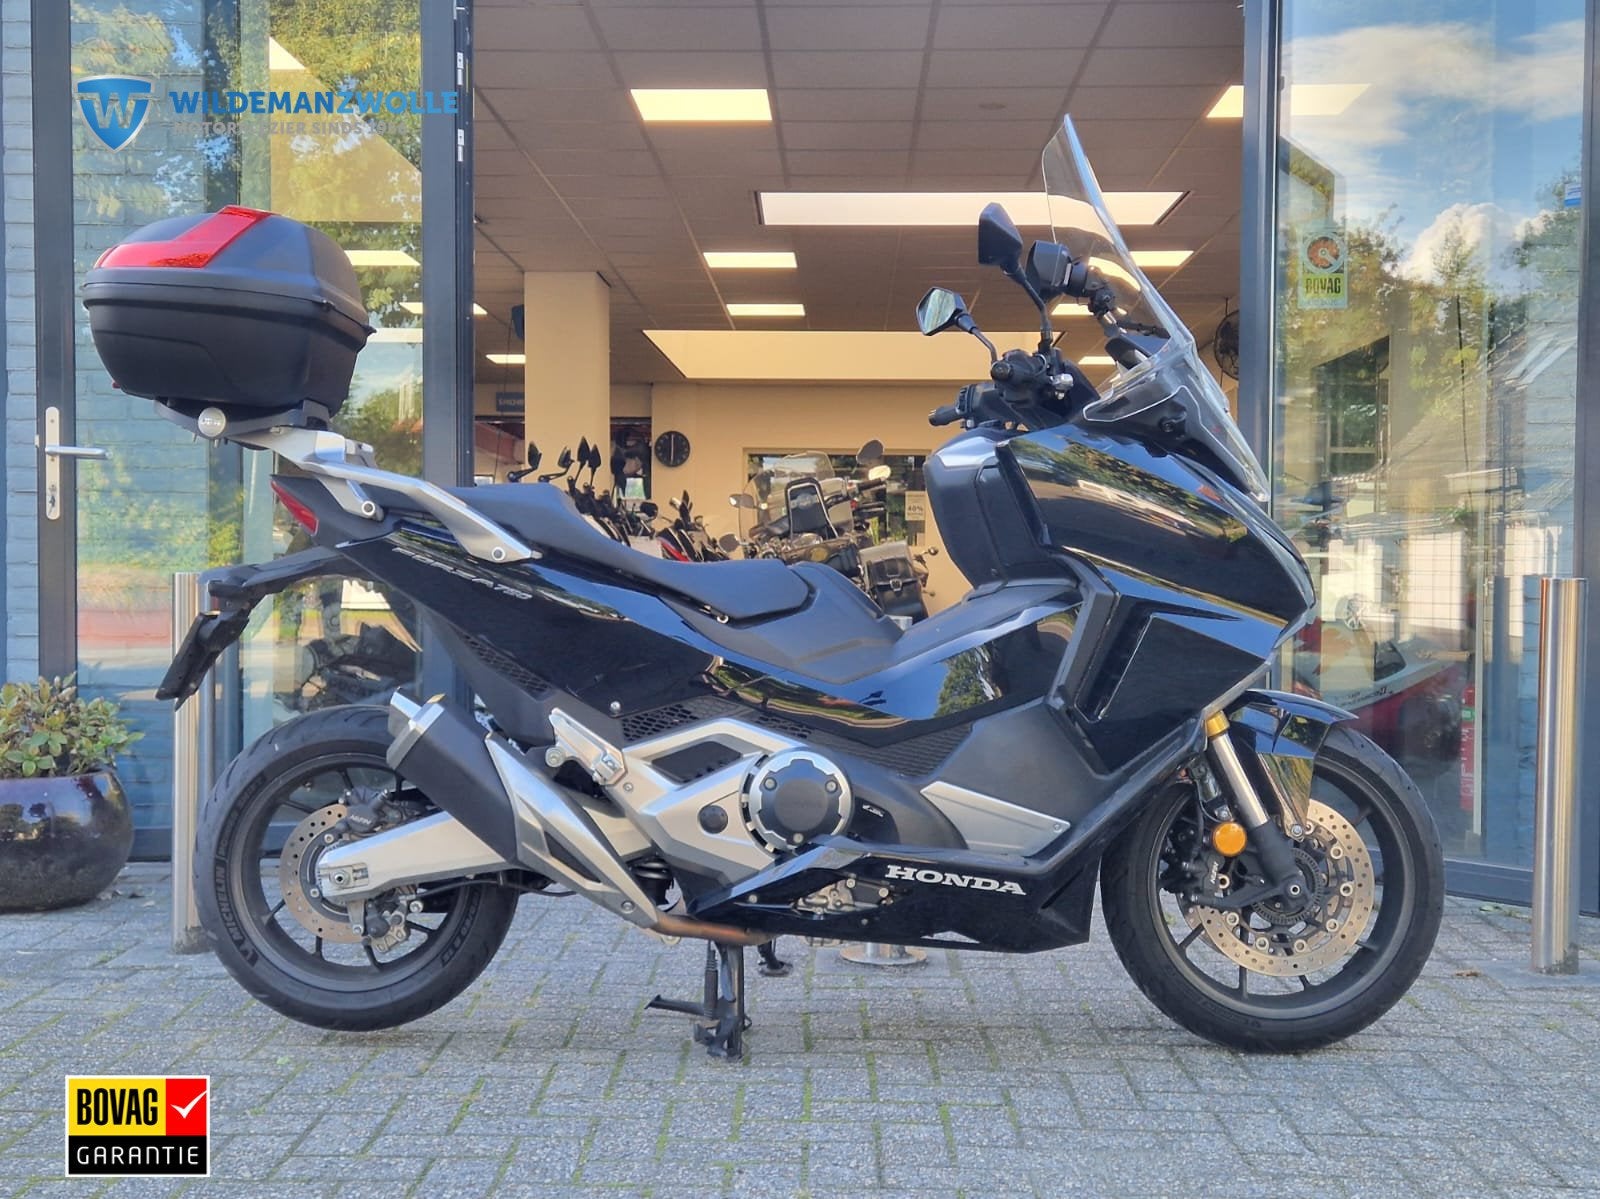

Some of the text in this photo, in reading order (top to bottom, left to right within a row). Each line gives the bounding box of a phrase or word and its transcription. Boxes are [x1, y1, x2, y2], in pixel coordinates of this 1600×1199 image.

[1305, 278, 1341, 293] BOVAG
[885, 864, 1027, 895] HONDA
[215, 866, 245, 943] MICHELIN
